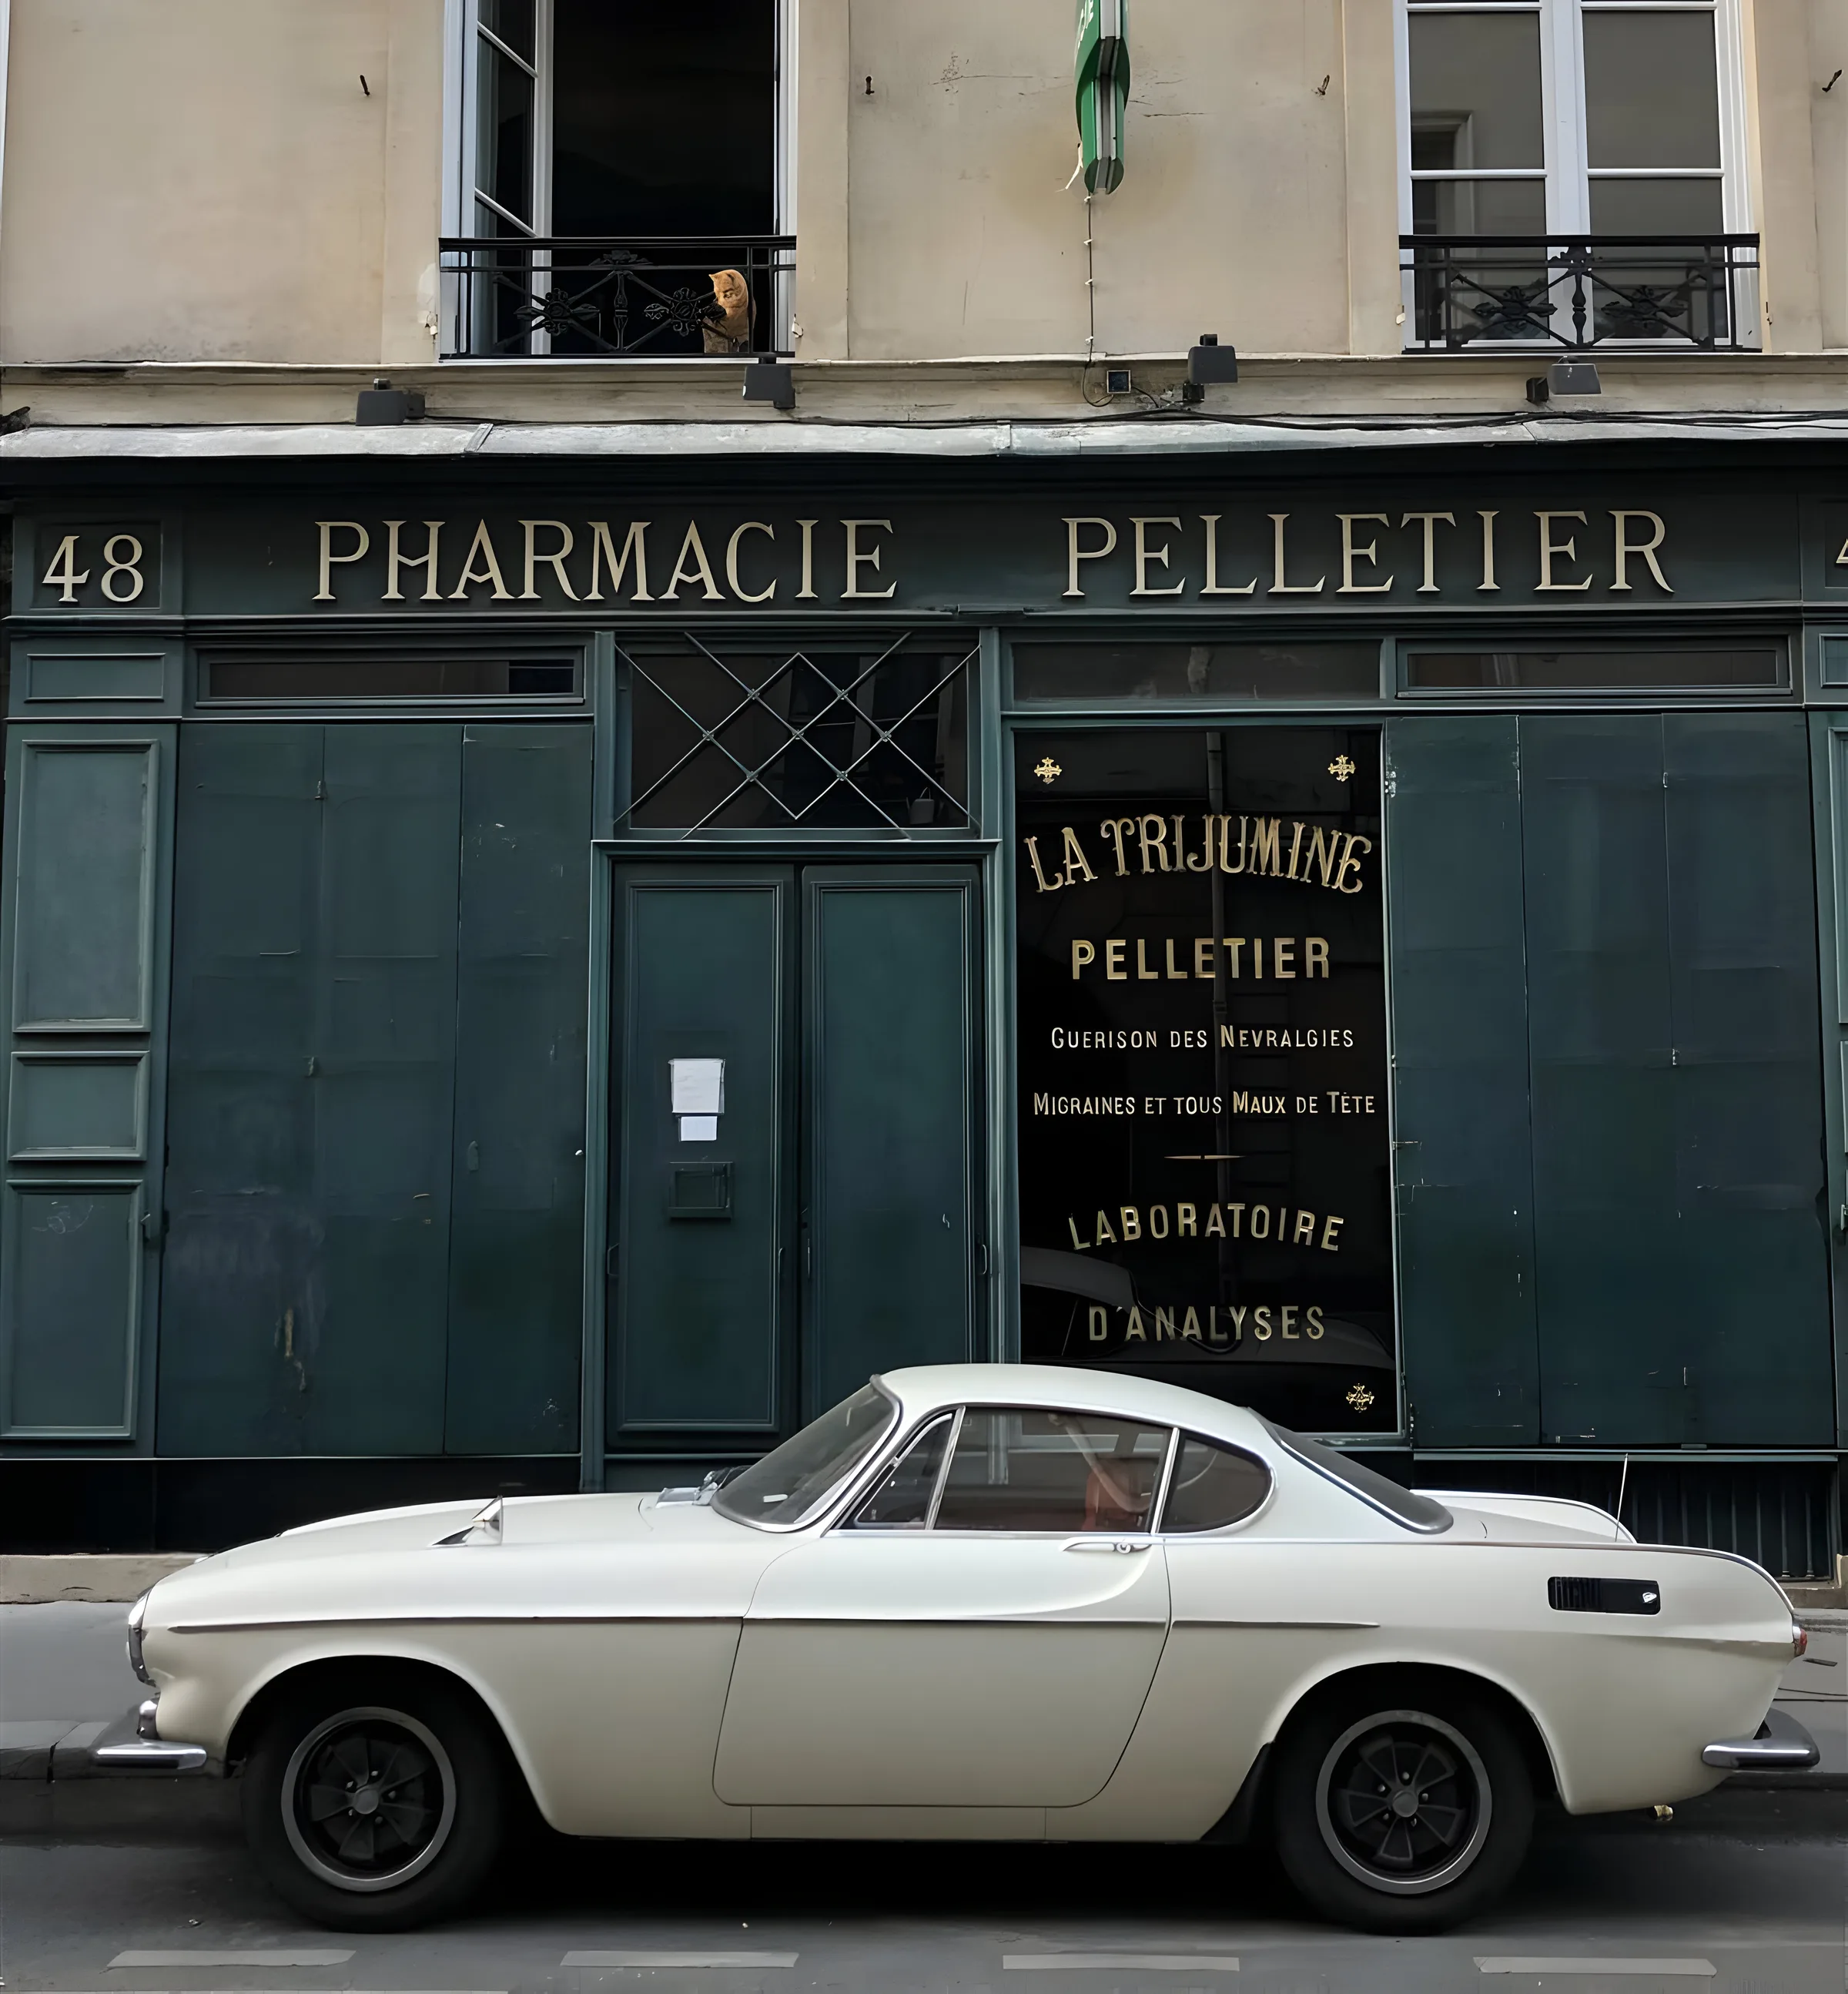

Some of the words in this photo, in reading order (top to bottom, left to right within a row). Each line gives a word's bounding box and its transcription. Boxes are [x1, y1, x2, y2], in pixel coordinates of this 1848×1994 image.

[43, 535, 143, 602] 48
[312, 519, 898, 602] PHARMACIE
[1062, 510, 1675, 595] PELLETIER
[1023, 826, 1099, 893] LA
[1100, 813, 1372, 893] TRIJUMINE
[1072, 937, 1329, 980] PELLETIER
[1034, 1092, 1136, 1115] MIGRAINES
[1145, 1097, 1167, 1115] ET
[1173, 1096, 1222, 1114] TOUS
[1233, 1091, 1287, 1114] MAUX
[1296, 1096, 1318, 1114] DE
[1069, 1202, 1344, 1252] LABORATOIRE
[1089, 1305, 1324, 1341] D'ANALYSES
